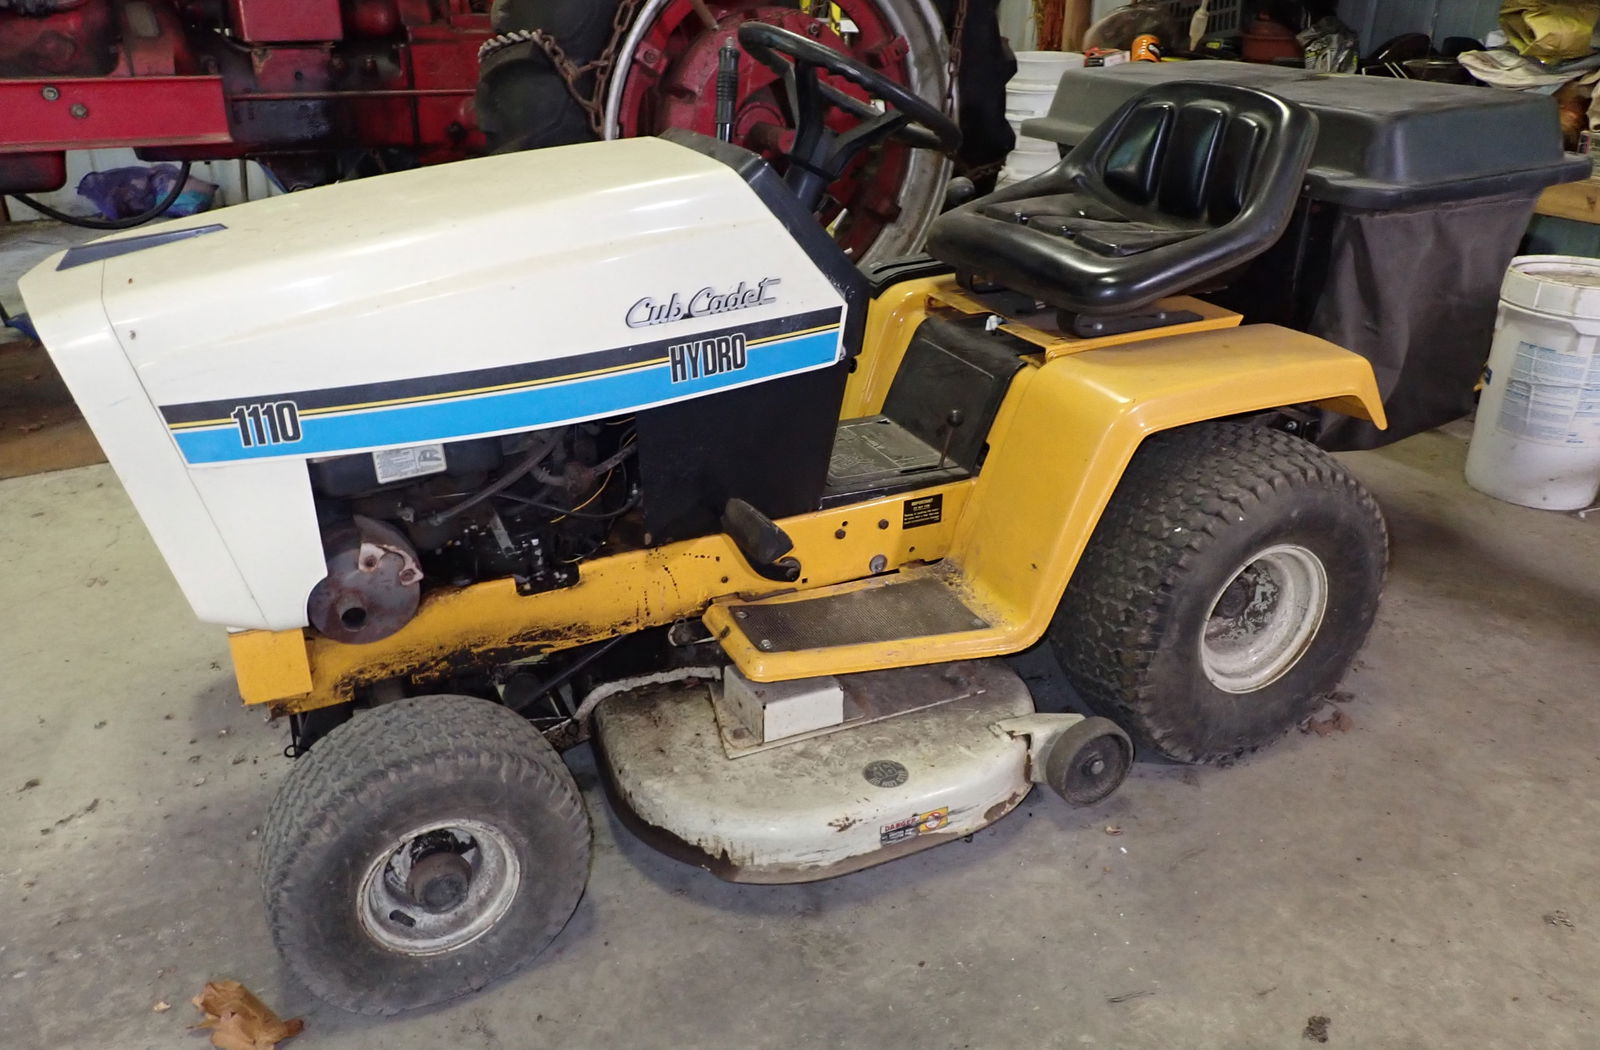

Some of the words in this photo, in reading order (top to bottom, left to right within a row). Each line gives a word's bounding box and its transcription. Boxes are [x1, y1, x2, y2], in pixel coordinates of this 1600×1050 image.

[625, 293, 685, 328] Cub
[688, 277, 781, 317] Cadet
[669, 334, 747, 383] HYDRO
[231, 402, 302, 447] 1110
